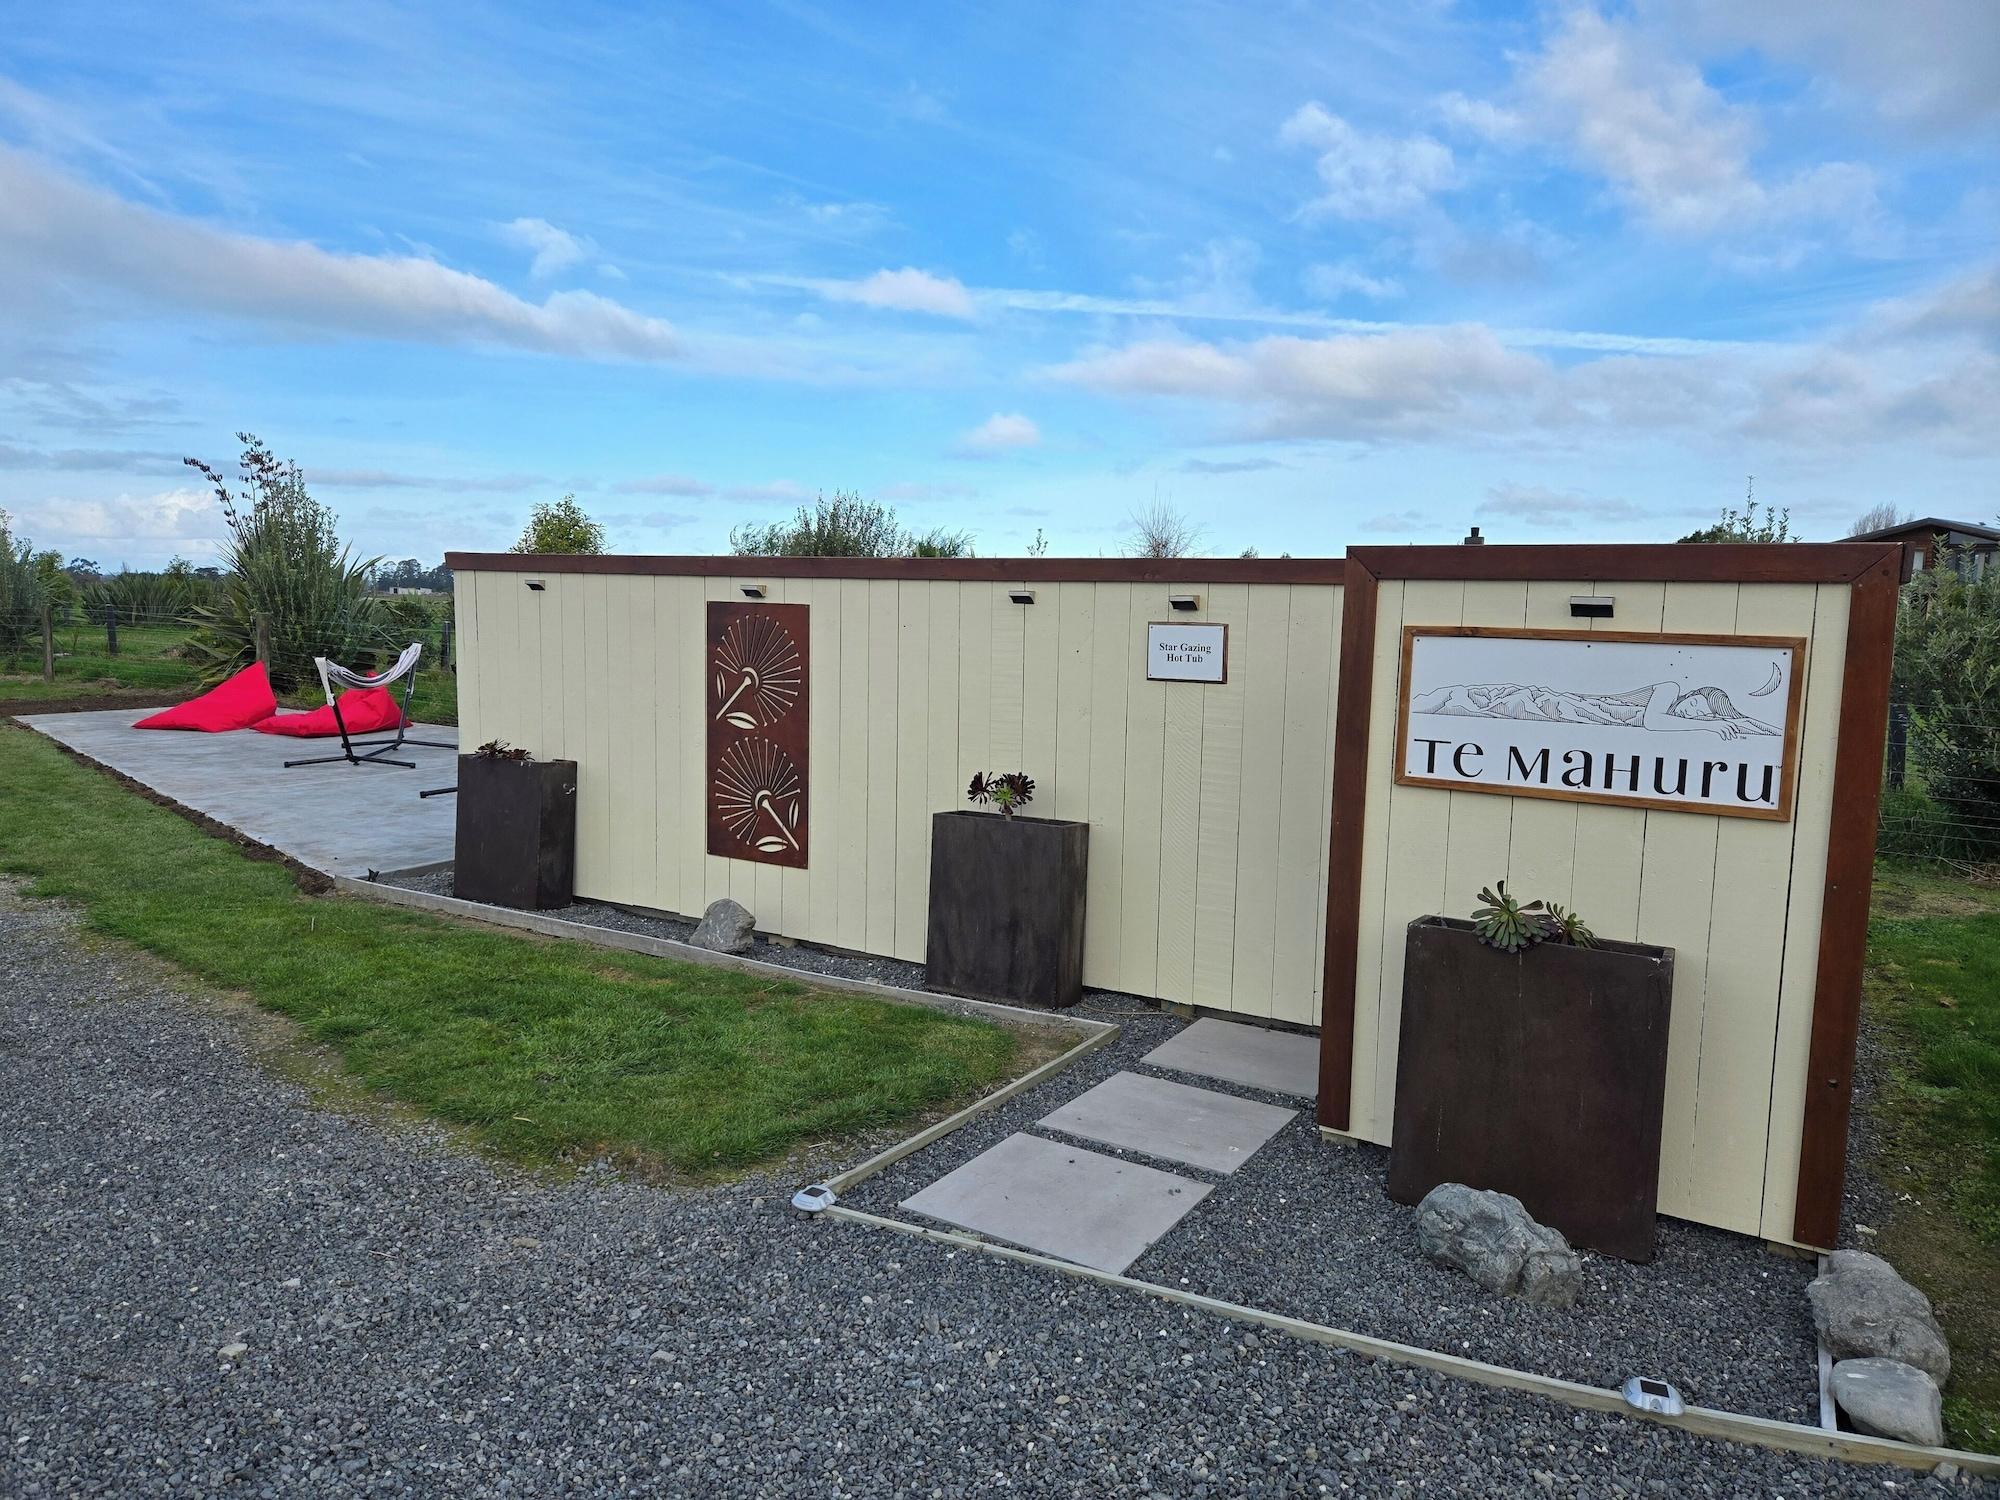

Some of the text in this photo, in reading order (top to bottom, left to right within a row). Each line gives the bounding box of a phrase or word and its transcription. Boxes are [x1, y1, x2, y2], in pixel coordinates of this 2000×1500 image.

[1159, 642, 1212, 654] Star Gazing
[1167, 653, 1203, 663] Hot Tub
[1414, 738, 1484, 778] Te
